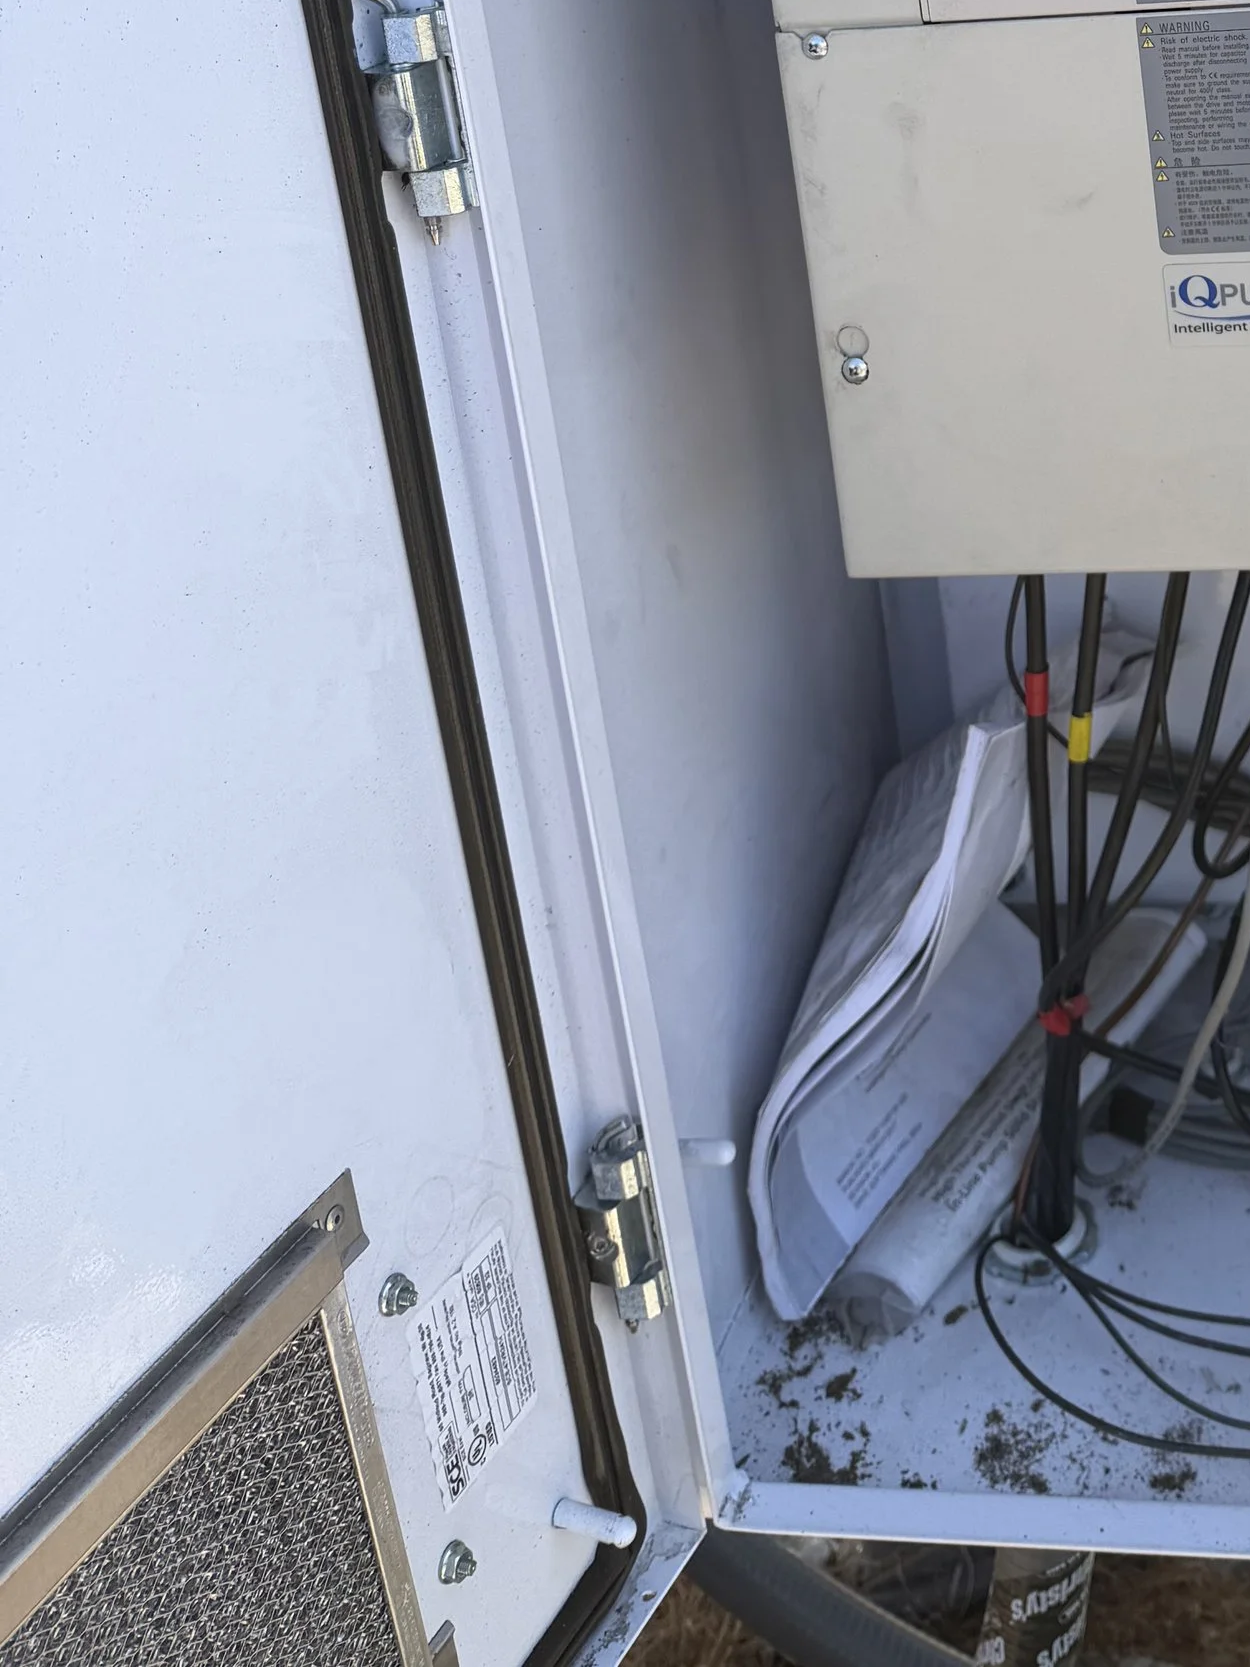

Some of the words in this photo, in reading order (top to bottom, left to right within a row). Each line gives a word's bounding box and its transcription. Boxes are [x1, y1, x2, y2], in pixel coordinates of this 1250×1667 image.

[1158, 20, 1210, 32] WARNING
[1192, 34, 1220, 43] electric
[1187, 130, 1220, 138] Surfaces
[1174, 321, 1248, 335] Intelligent
[445, 1452, 464, 1499] SCE
